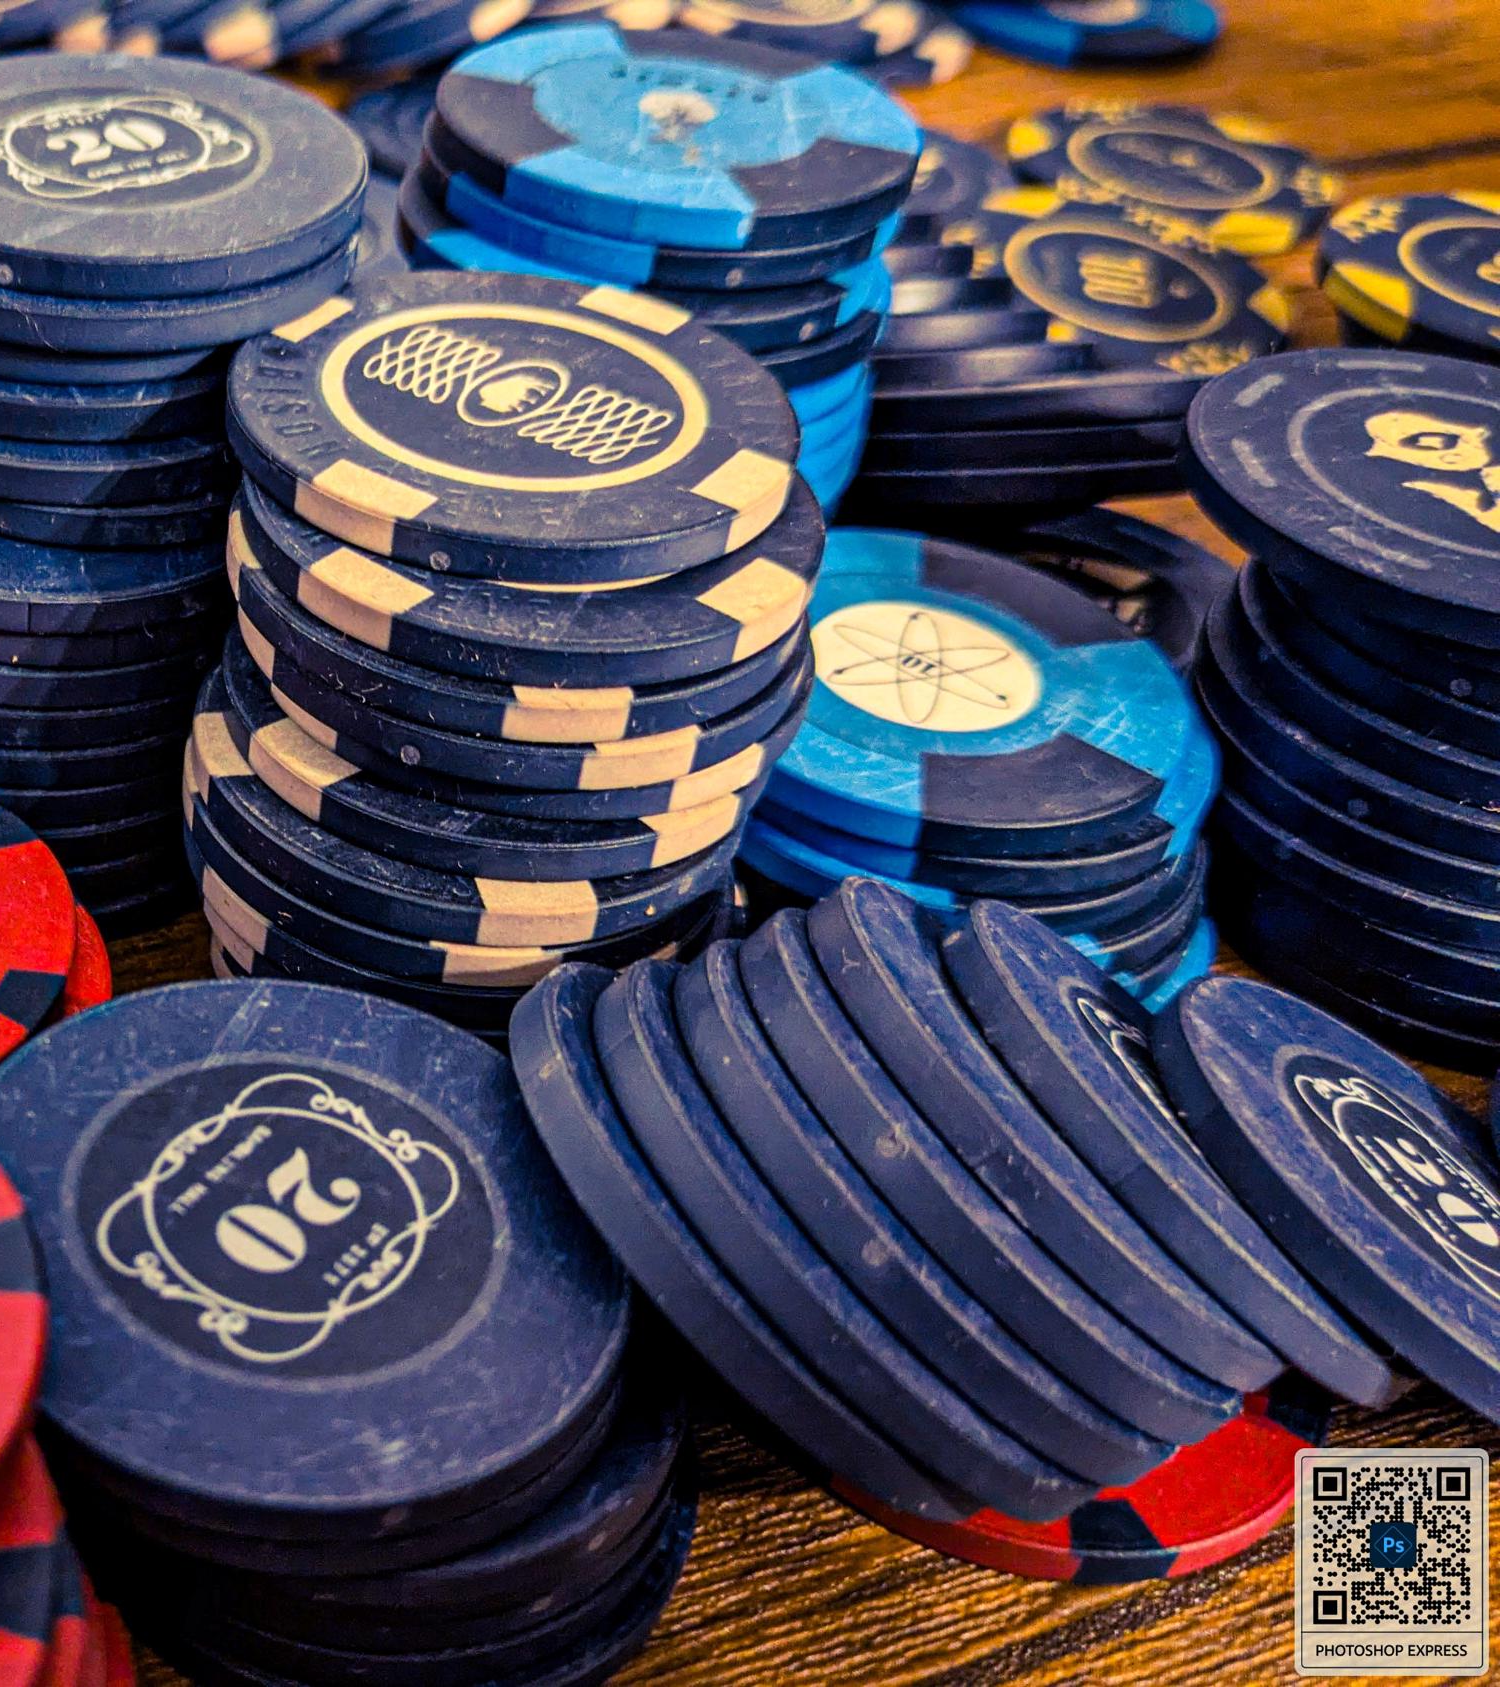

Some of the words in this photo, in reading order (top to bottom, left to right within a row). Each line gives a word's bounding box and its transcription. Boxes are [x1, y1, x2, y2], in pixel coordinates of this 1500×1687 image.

[46, 118, 167, 166] 20
[216, 1147, 361, 1274] 20
[1372, 1136, 1500, 1247] 20
